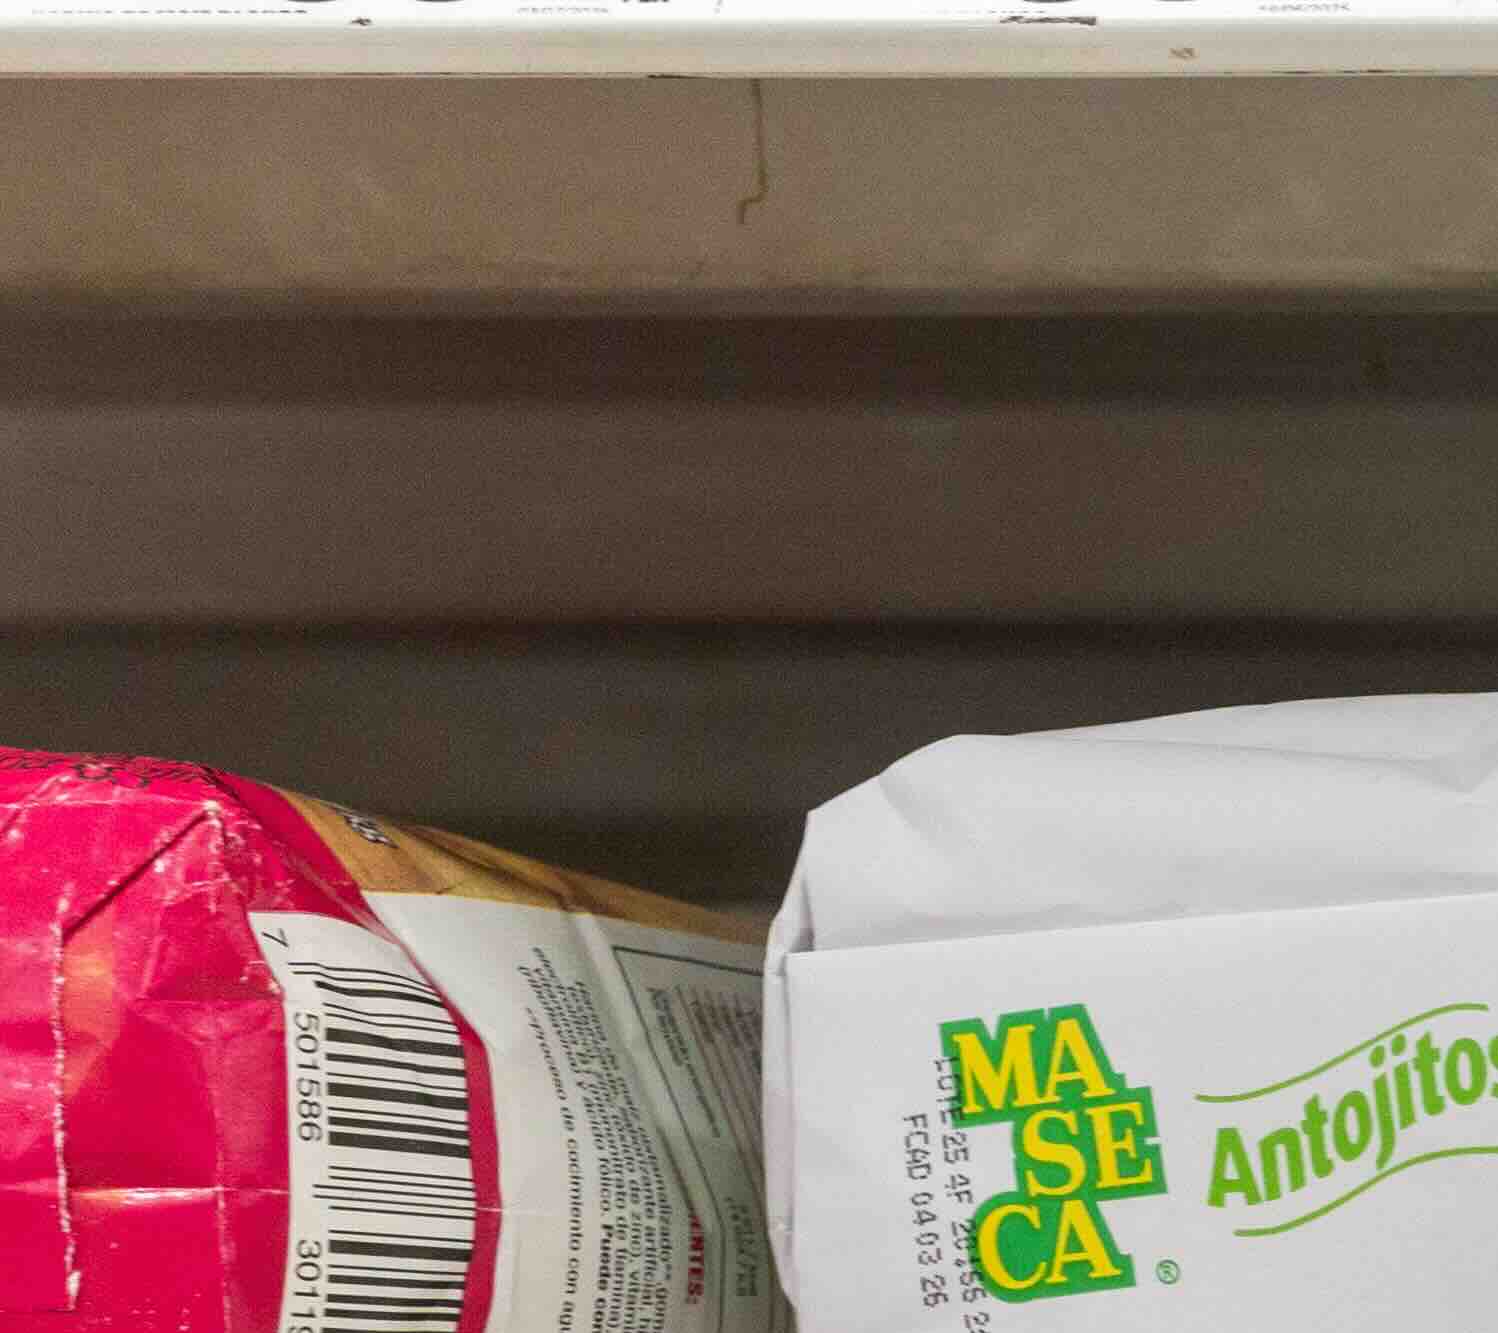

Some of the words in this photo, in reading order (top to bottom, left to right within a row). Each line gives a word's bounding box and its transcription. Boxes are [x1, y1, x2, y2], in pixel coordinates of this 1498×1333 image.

[291, 1012, 323, 1143] 501586
[951, 1015, 1114, 1116] MA
[904, 1114, 930, 1179] FCAD
[1020, 1099, 1157, 1198] SE
[978, 1201, 1122, 1293] CA
